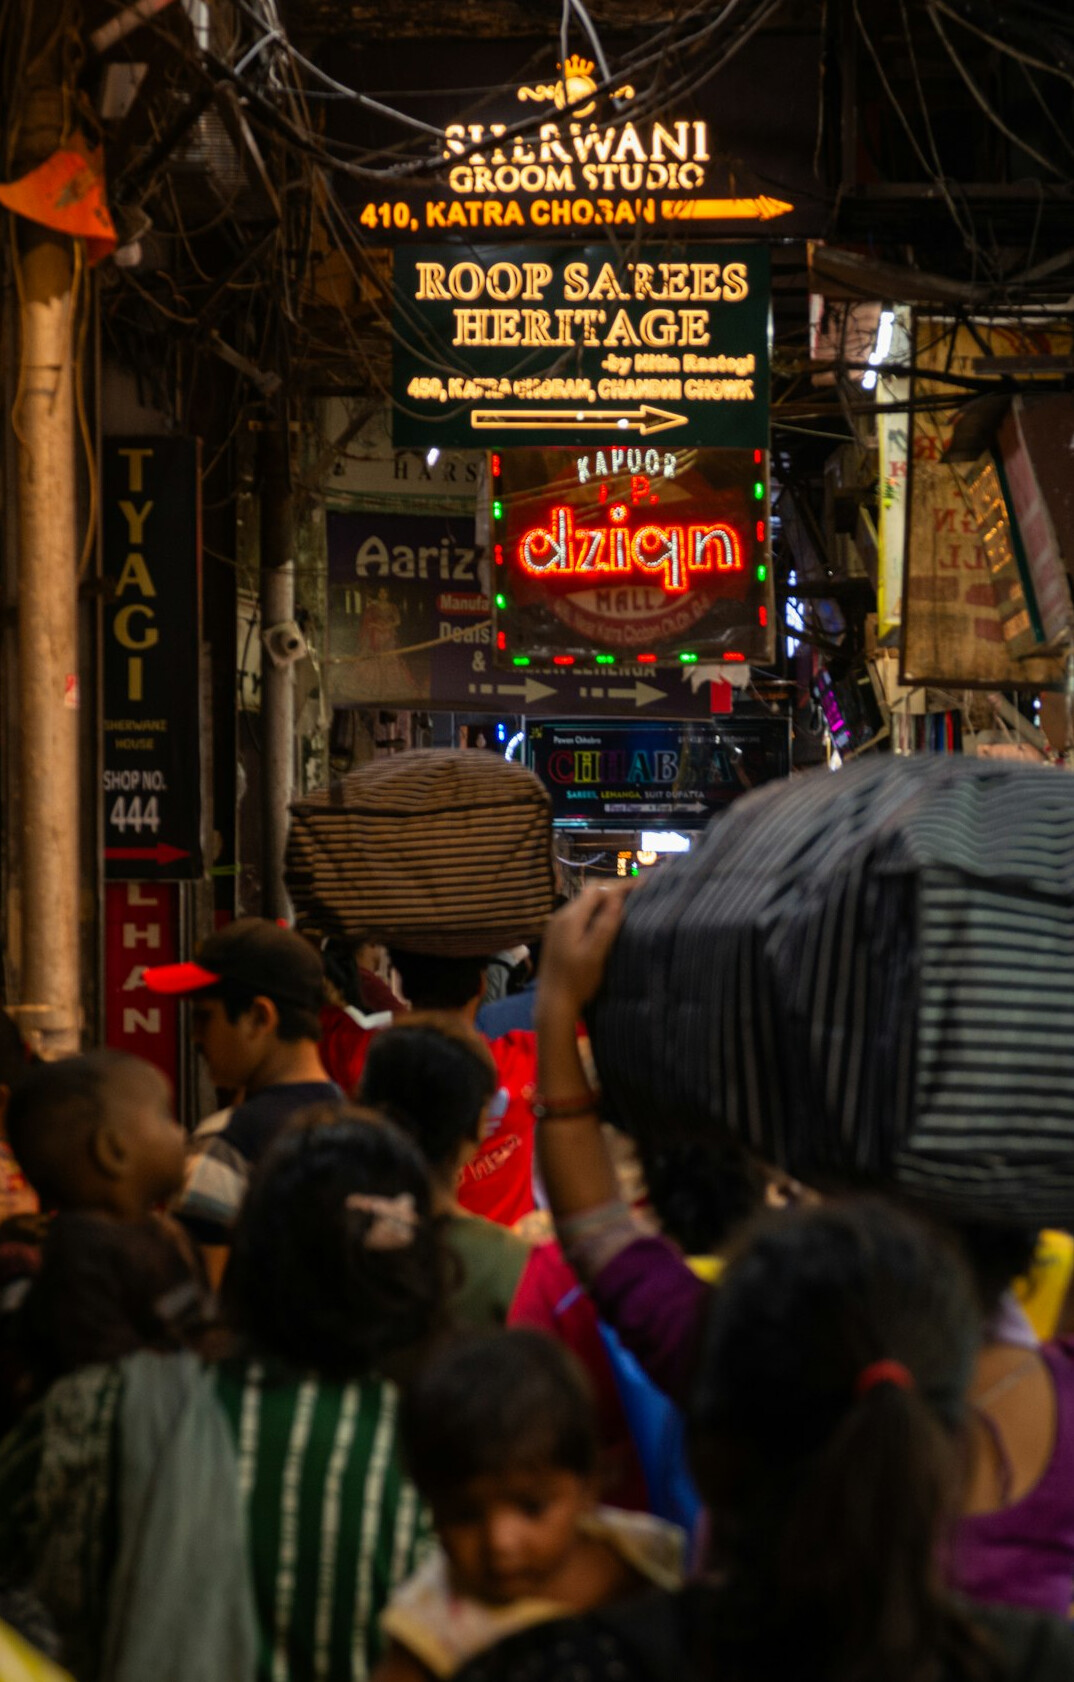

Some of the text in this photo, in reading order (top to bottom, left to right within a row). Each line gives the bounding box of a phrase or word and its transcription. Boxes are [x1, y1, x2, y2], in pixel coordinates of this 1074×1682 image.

[449, 162, 705, 194] GROOM STUDIO
[359, 202, 419, 232] 410,
[426, 200, 526, 227] KATRA
[414, 261, 750, 303] ROOP SAREES
[451, 308, 712, 347] HERITAGE
[598, 378, 682, 399] CHANDNI
[684, 378, 754, 399] CHOWK
[355, 534, 476, 582] Aariz
[112, 447, 160, 702] TYAGI
[472, 650, 486, 672] &
[115, 737, 155, 751] HOUSE
[103, 769, 168, 792] SHOP NO.
[109, 794, 162, 835] 444
